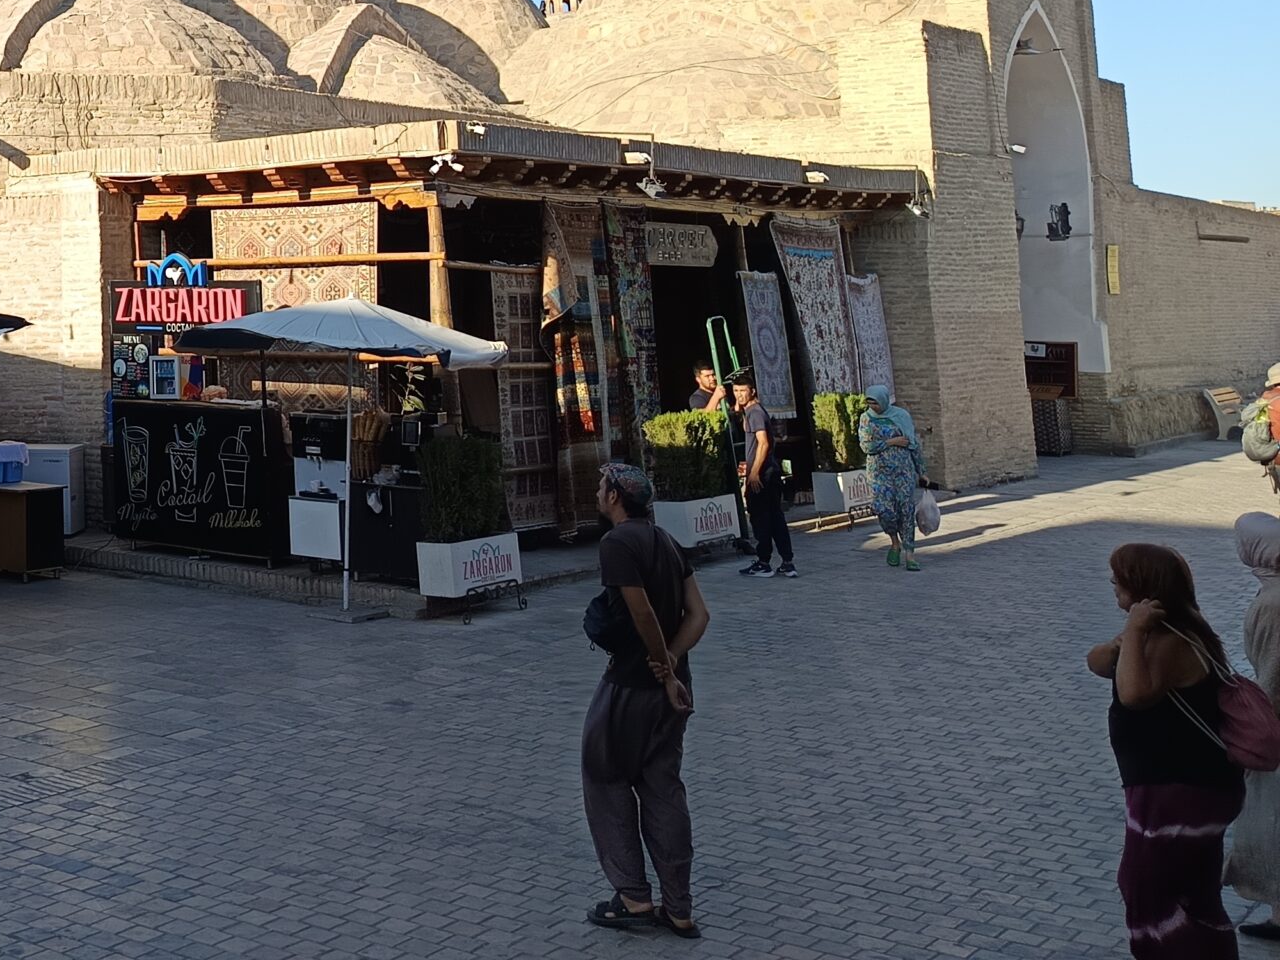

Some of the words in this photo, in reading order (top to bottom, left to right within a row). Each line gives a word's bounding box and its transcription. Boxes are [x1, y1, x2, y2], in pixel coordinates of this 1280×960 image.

[647, 228, 707, 249] CARPET
[115, 287, 247, 323] ZARGARON
[123, 335, 141, 344] MENU
[694, 511, 733, 533] ZARGARON
[462, 553, 513, 580] ZARGARON
